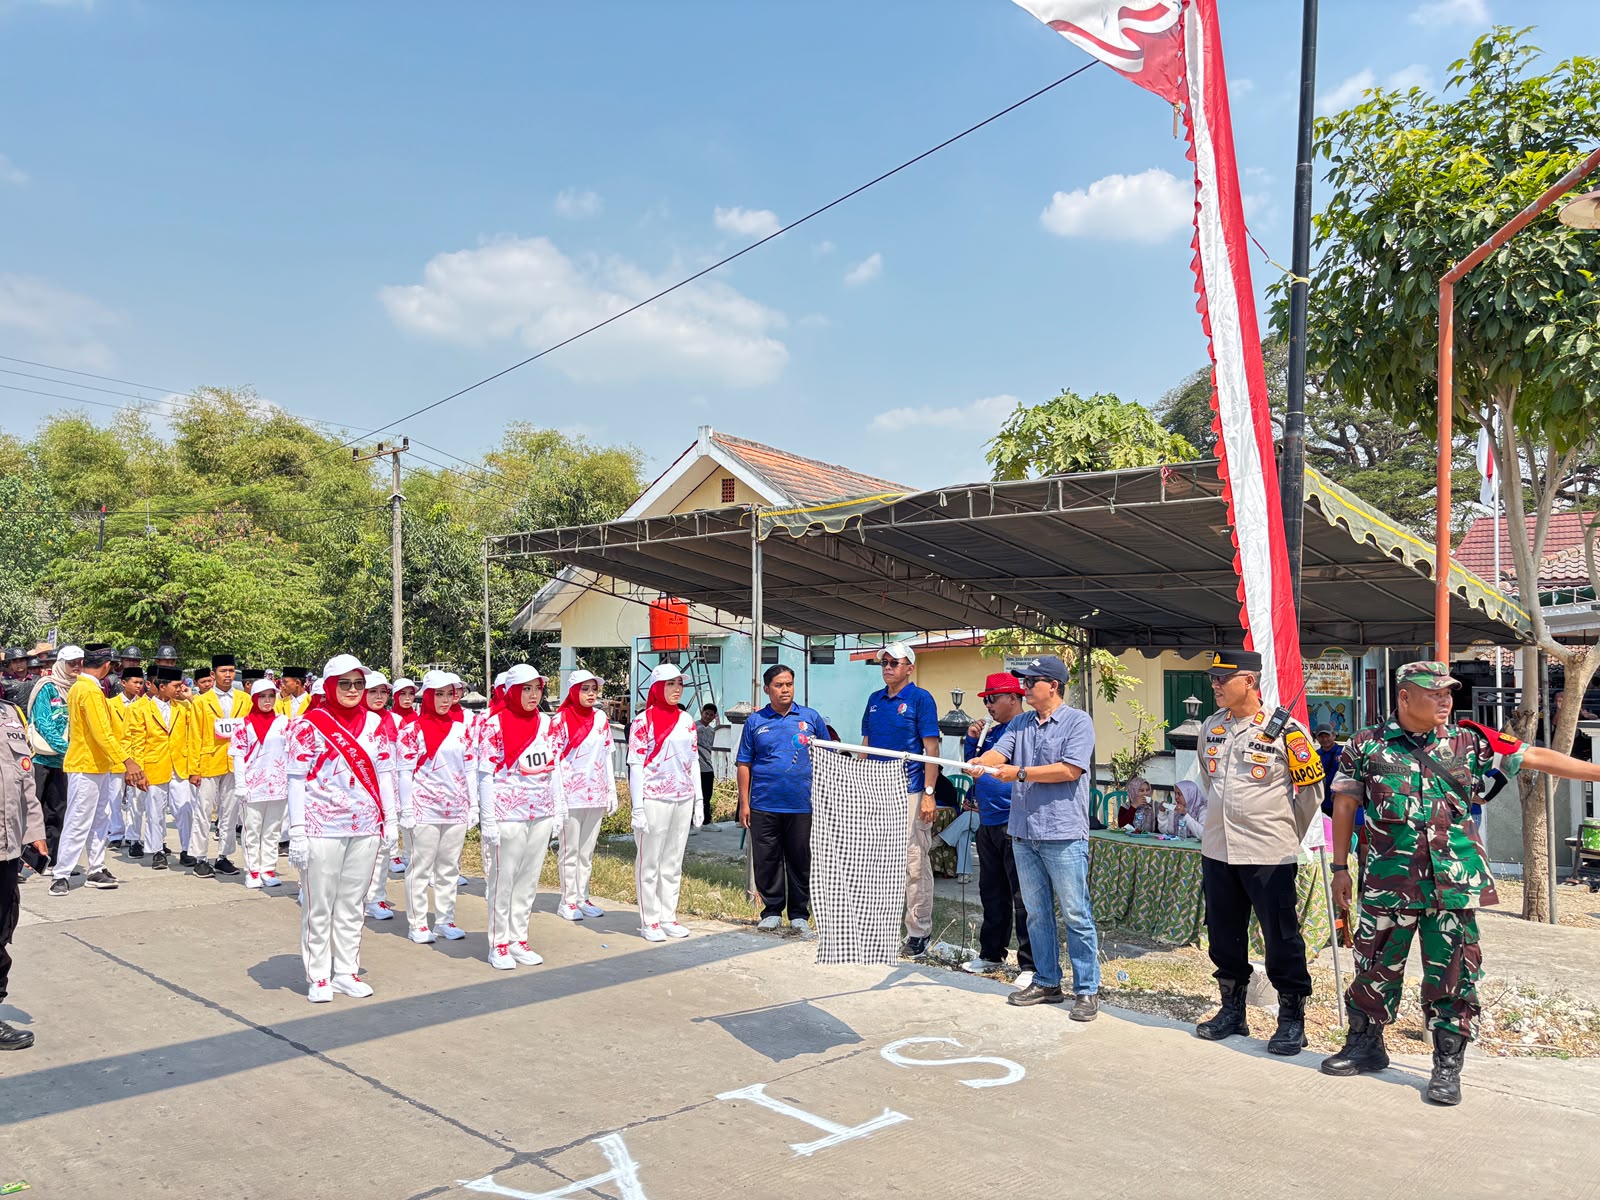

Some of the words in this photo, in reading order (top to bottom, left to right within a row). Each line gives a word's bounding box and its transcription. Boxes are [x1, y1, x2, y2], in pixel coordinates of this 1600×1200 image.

[6, 732, 26, 741] POLR
[1248, 741, 1276, 754] POLRI
[525, 752, 547, 767] 101
